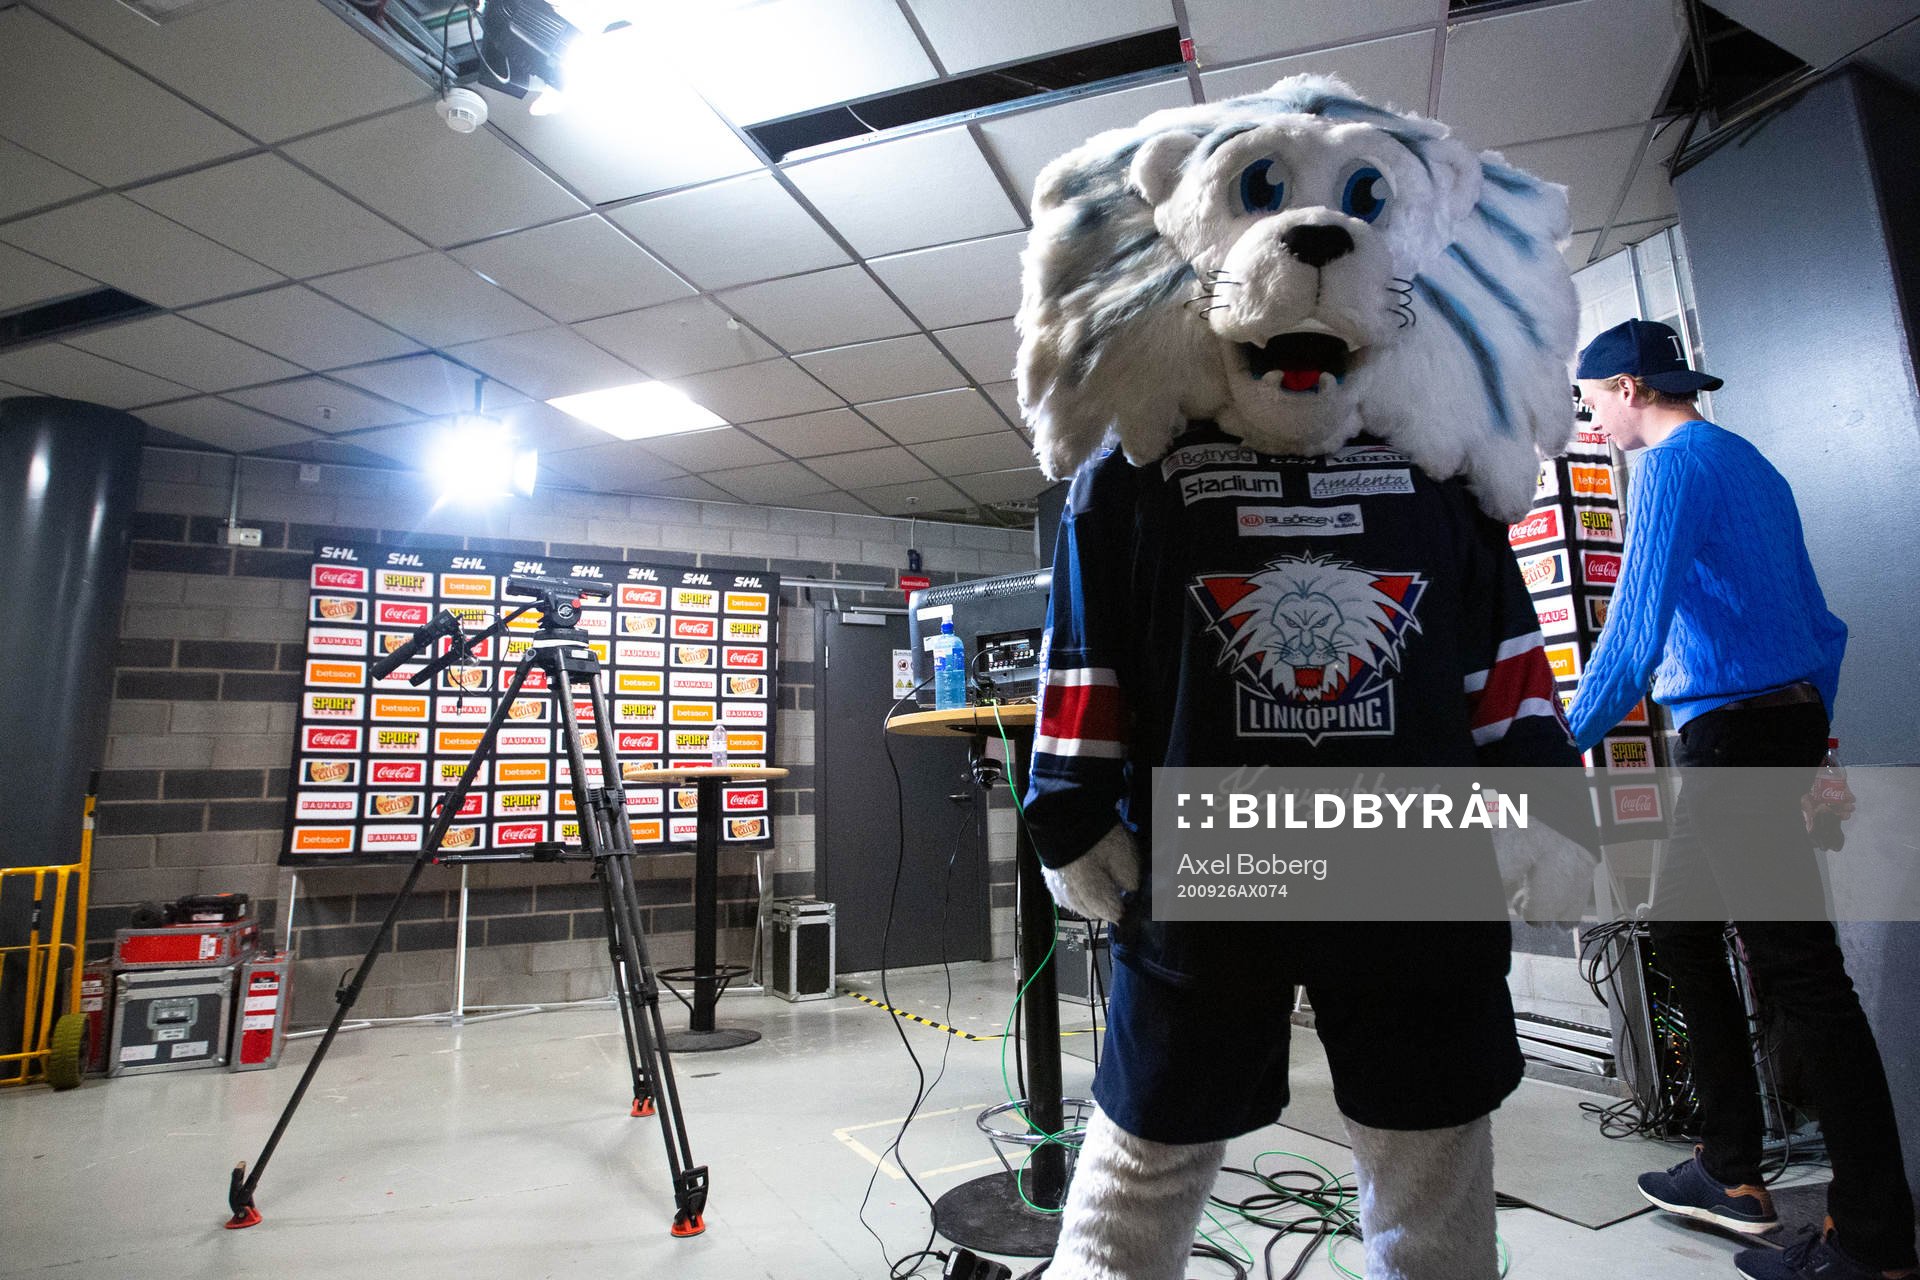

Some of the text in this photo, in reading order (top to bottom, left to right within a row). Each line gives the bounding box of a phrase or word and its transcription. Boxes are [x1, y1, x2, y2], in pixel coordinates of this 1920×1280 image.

[1181, 448, 1253, 464] Botrygg
[1185, 475, 1279, 499] stadium
[1313, 473, 1409, 490] Amdenta
[320, 546, 358, 561] SHL
[386, 552, 424, 567] SHL
[450, 556, 486, 570] SHL
[511, 560, 546, 575] SHL
[570, 565, 604, 578] SHL
[627, 567, 659, 582] SHL
[384, 574, 424, 588] SPORT
[682, 572, 712, 586] SHL
[733, 576, 762, 588] SHL
[449, 582, 486, 591] betsson
[679, 592, 712, 605] SPORT
[731, 599, 762, 607] betsson
[1538, 608, 1568, 625] HAUS
[729, 623, 762, 635] SPORT
[313, 636, 362, 647] BAUHAUS
[620, 649, 660, 658] BAUHAUS
[316, 670, 356, 678] betsson
[623, 679, 656, 687] betsson
[674, 680, 713, 689] BAUHAUS
[312, 696, 355, 711] SPORT
[381, 704, 420, 712] betsson
[441, 705, 486, 714] BAHAUS
[621, 704, 656, 716] SPORT
[677, 709, 709, 717] betsson
[726, 710, 763, 718] BAUHAUS
[1250, 698, 1382, 730] LINKÖPING
[378, 731, 419, 744] SPORT
[501, 737, 546, 745] BAUHAUS
[676, 733, 709, 746] SPORT
[1611, 742, 1647, 762] SPORT
[441, 764, 468, 777] SPO
[560, 767, 603, 775] BAAUS
[302, 801, 352, 810] BAUHAUS
[502, 793, 541, 807] SPORT
[674, 825, 697, 834] BAUH
[303, 836, 344, 844] betsson
[367, 833, 417, 842] BAUHAUS
